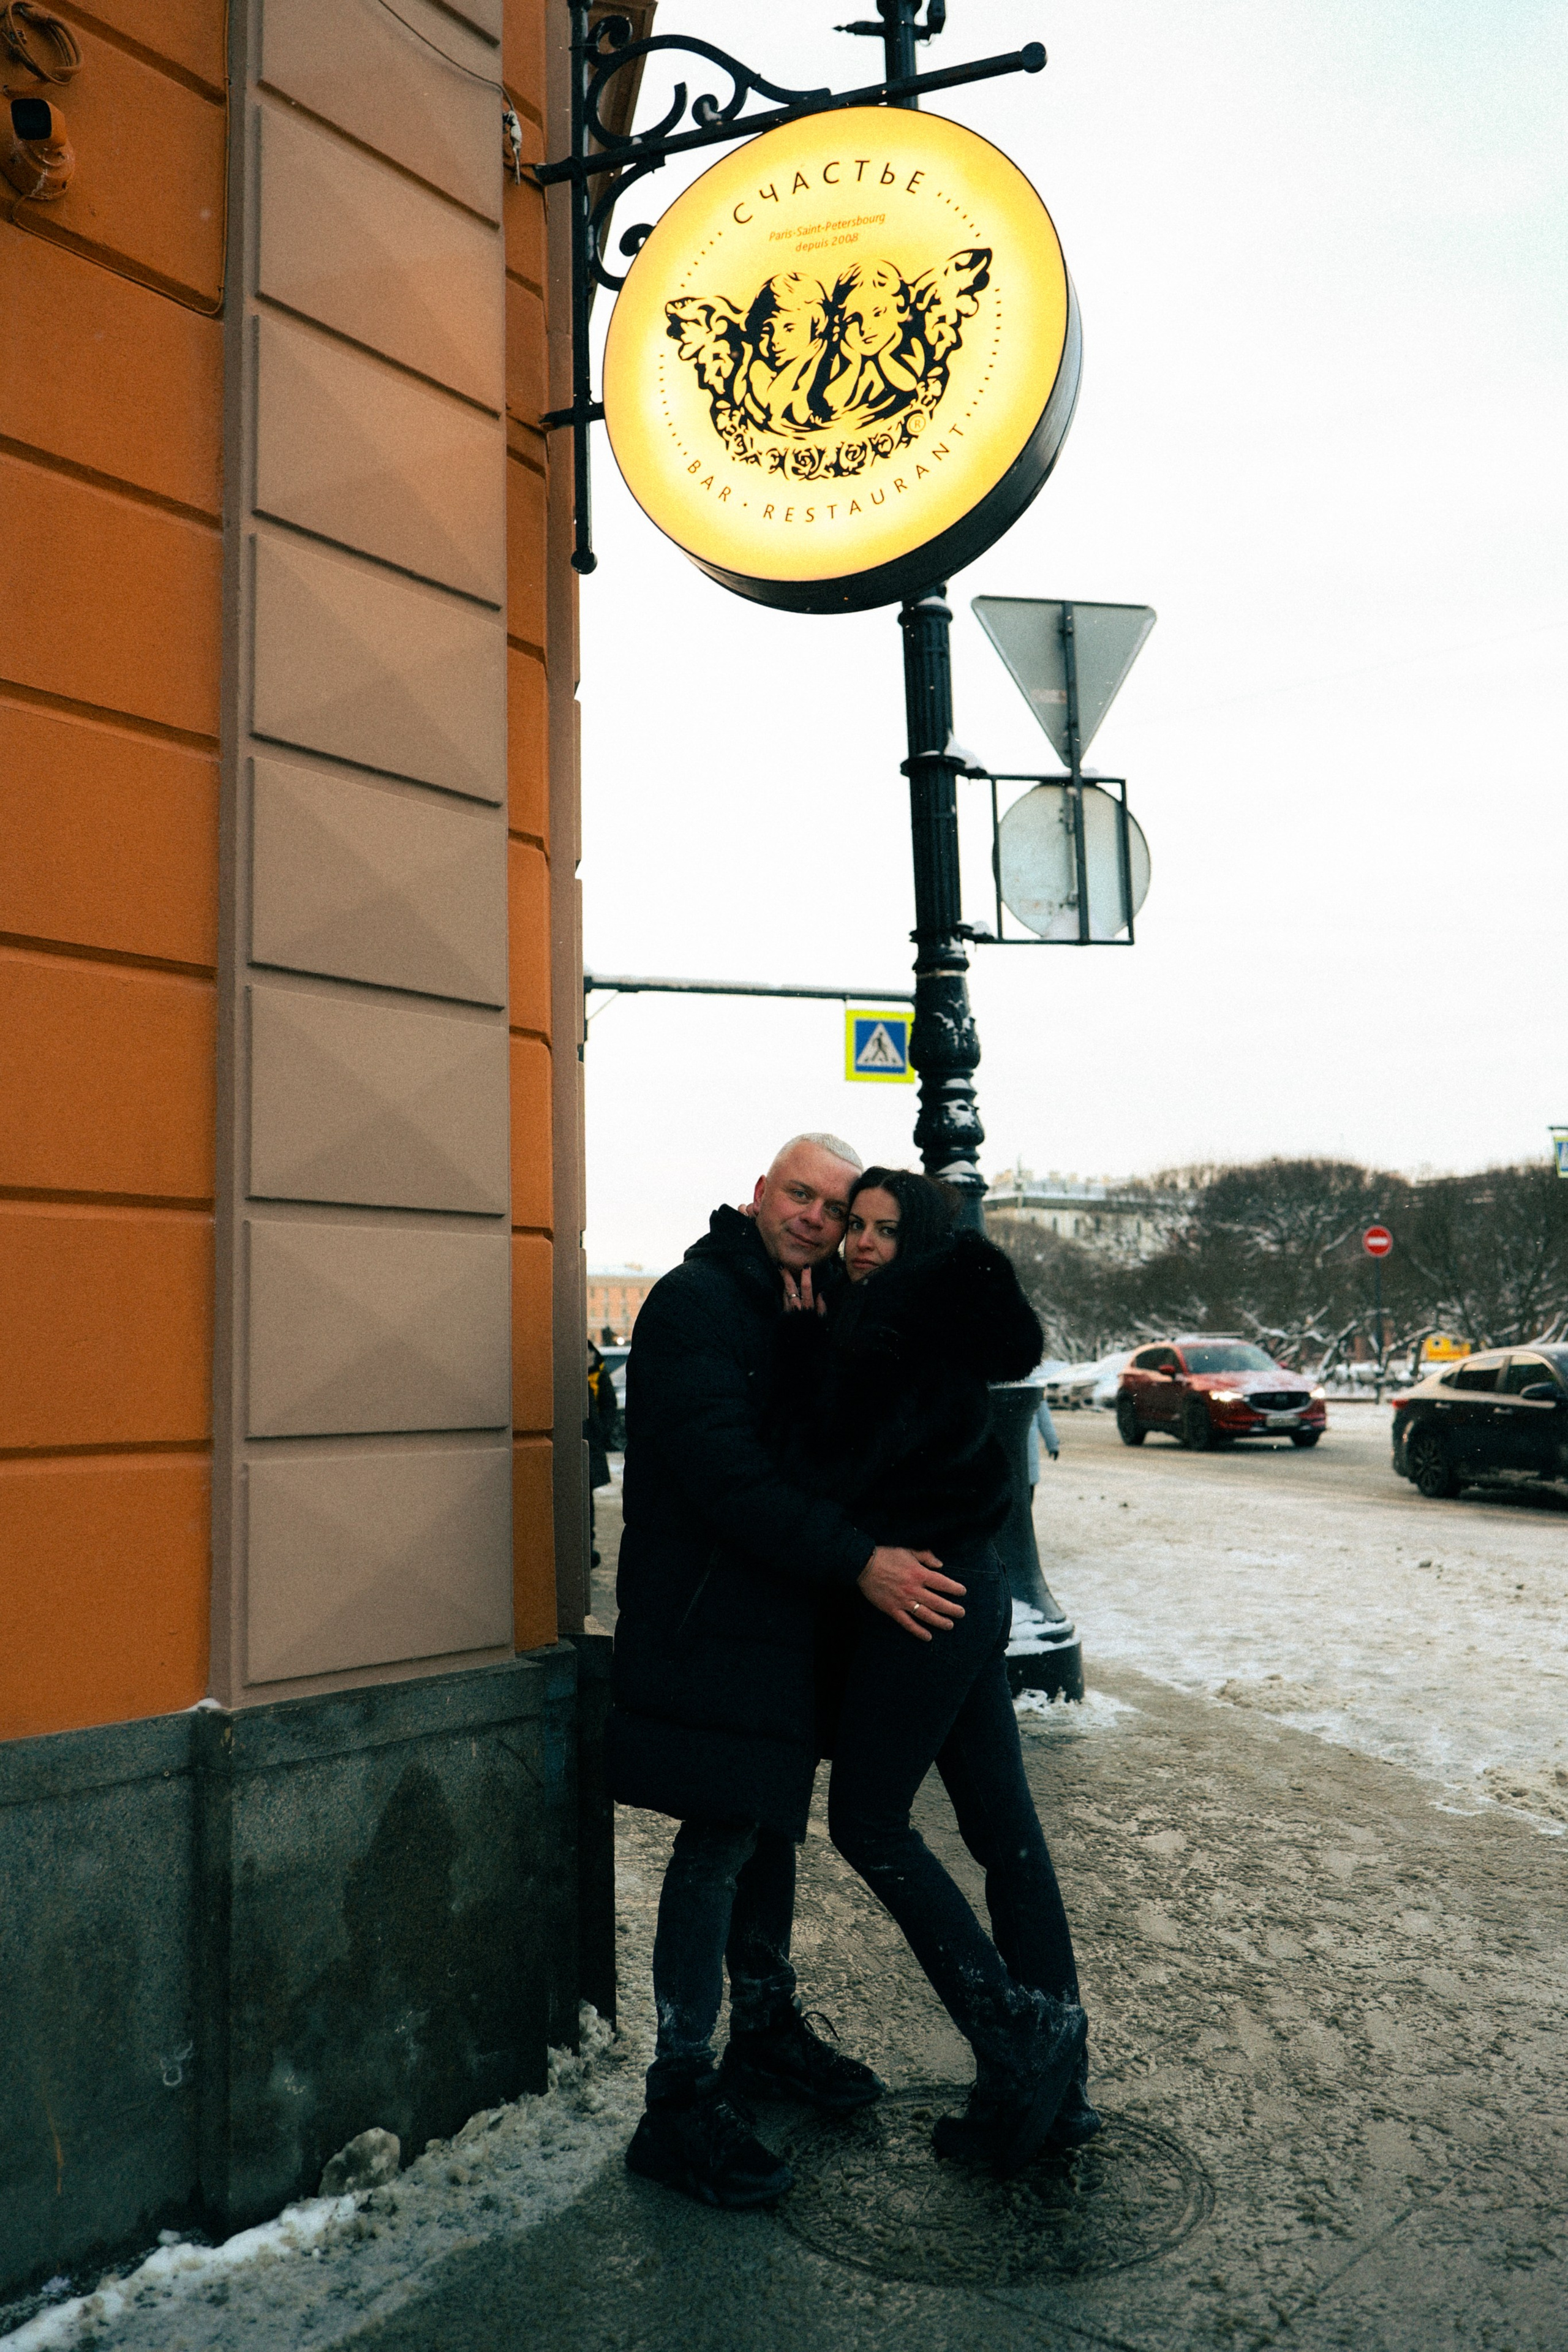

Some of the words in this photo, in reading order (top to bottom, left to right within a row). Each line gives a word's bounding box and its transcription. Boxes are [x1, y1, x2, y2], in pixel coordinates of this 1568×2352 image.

[733, 160, 925, 224] СЧАСТЬЕ
[796, 239, 828, 252] depuis
[832, 233, 859, 246] 2008
[687, 460, 732, 502] BAR
[763, 424, 964, 522] RESTAURANT
